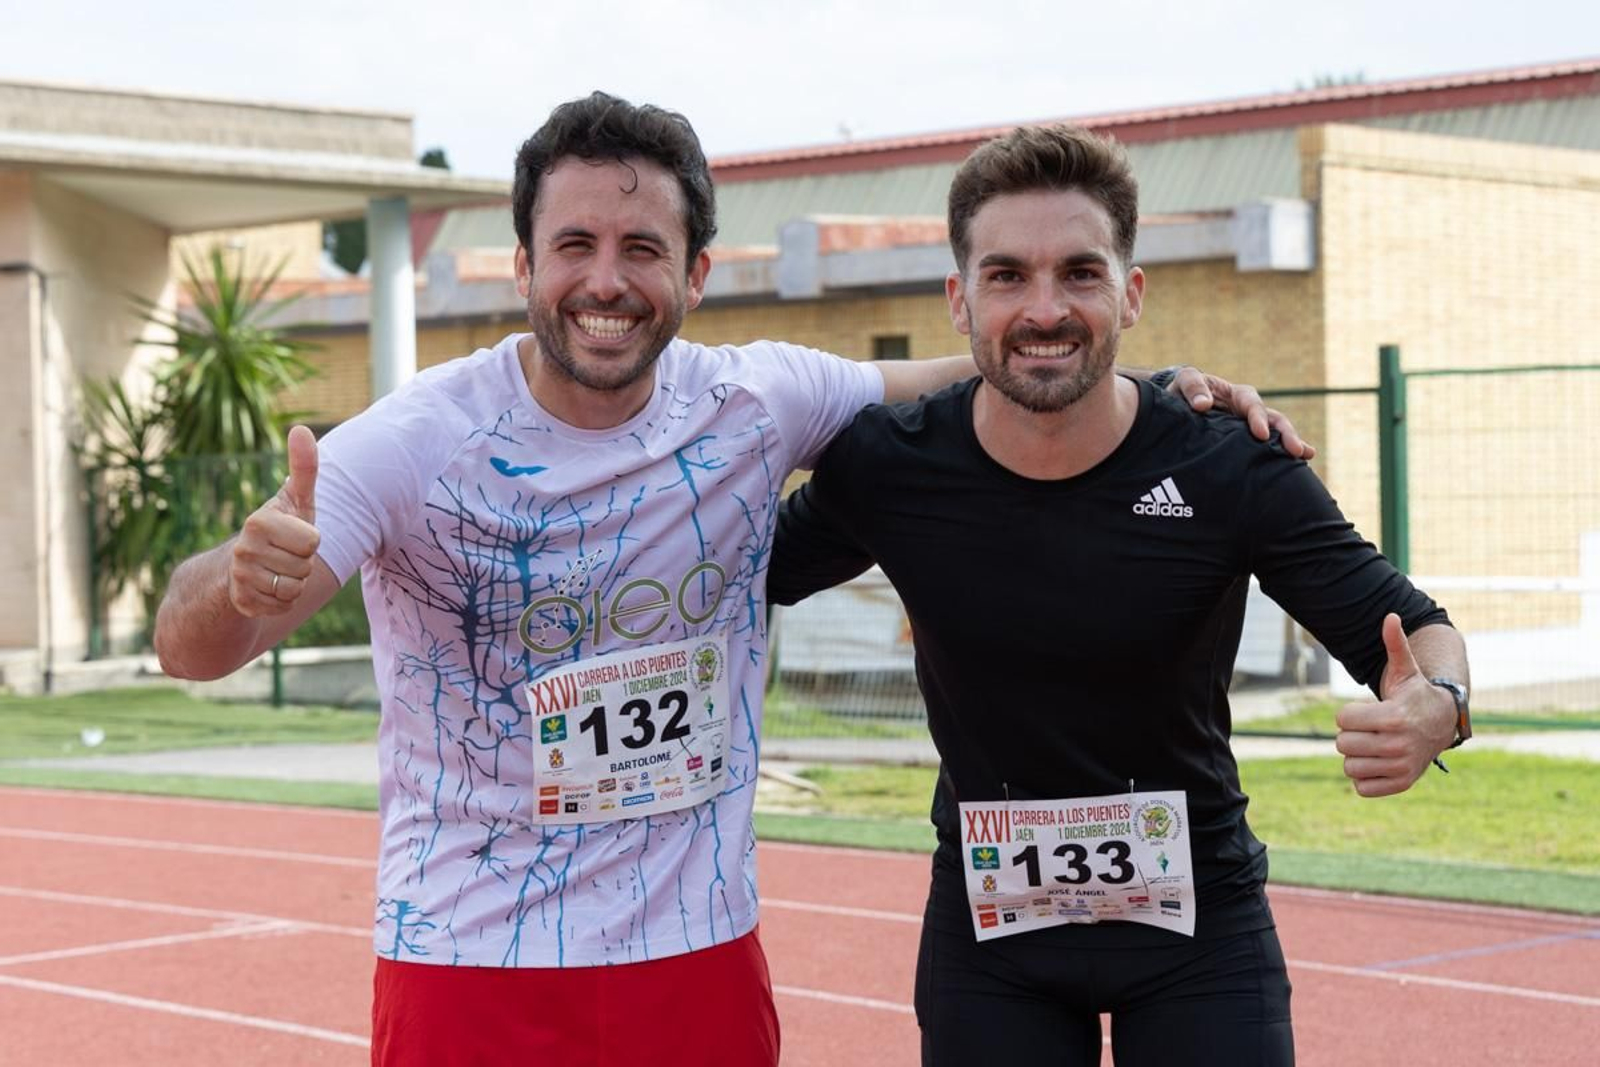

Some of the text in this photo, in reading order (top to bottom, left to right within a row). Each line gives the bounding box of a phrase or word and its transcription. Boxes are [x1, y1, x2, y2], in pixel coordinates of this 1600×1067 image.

[1133, 503, 1193, 517] adidas
[577, 666, 621, 688] CARRERA
[622, 665, 630, 679] A
[630, 659, 649, 678] LOS
[649, 651, 687, 674] PUENTES
[532, 673, 578, 716] XXVI
[629, 675, 669, 695] DICIEMBRE
[670, 670, 688, 687] 2024
[579, 690, 691, 757] 132
[610, 751, 672, 773] BARTOLOMÉ
[965, 809, 1011, 844] XXVI
[1013, 810, 1056, 826] CARRERA
[1058, 809, 1065, 824] A
[1067, 808, 1085, 824] LOS
[1087, 804, 1130, 823] PUENTES
[1058, 828, 1063, 840] 1
[1065, 824, 1108, 840] DICIEMBRE
[1110, 822, 1131, 836] 2024
[1013, 840, 1135, 887] 133
[1047, 887, 1108, 896] JOSÉ ÁNGEL
